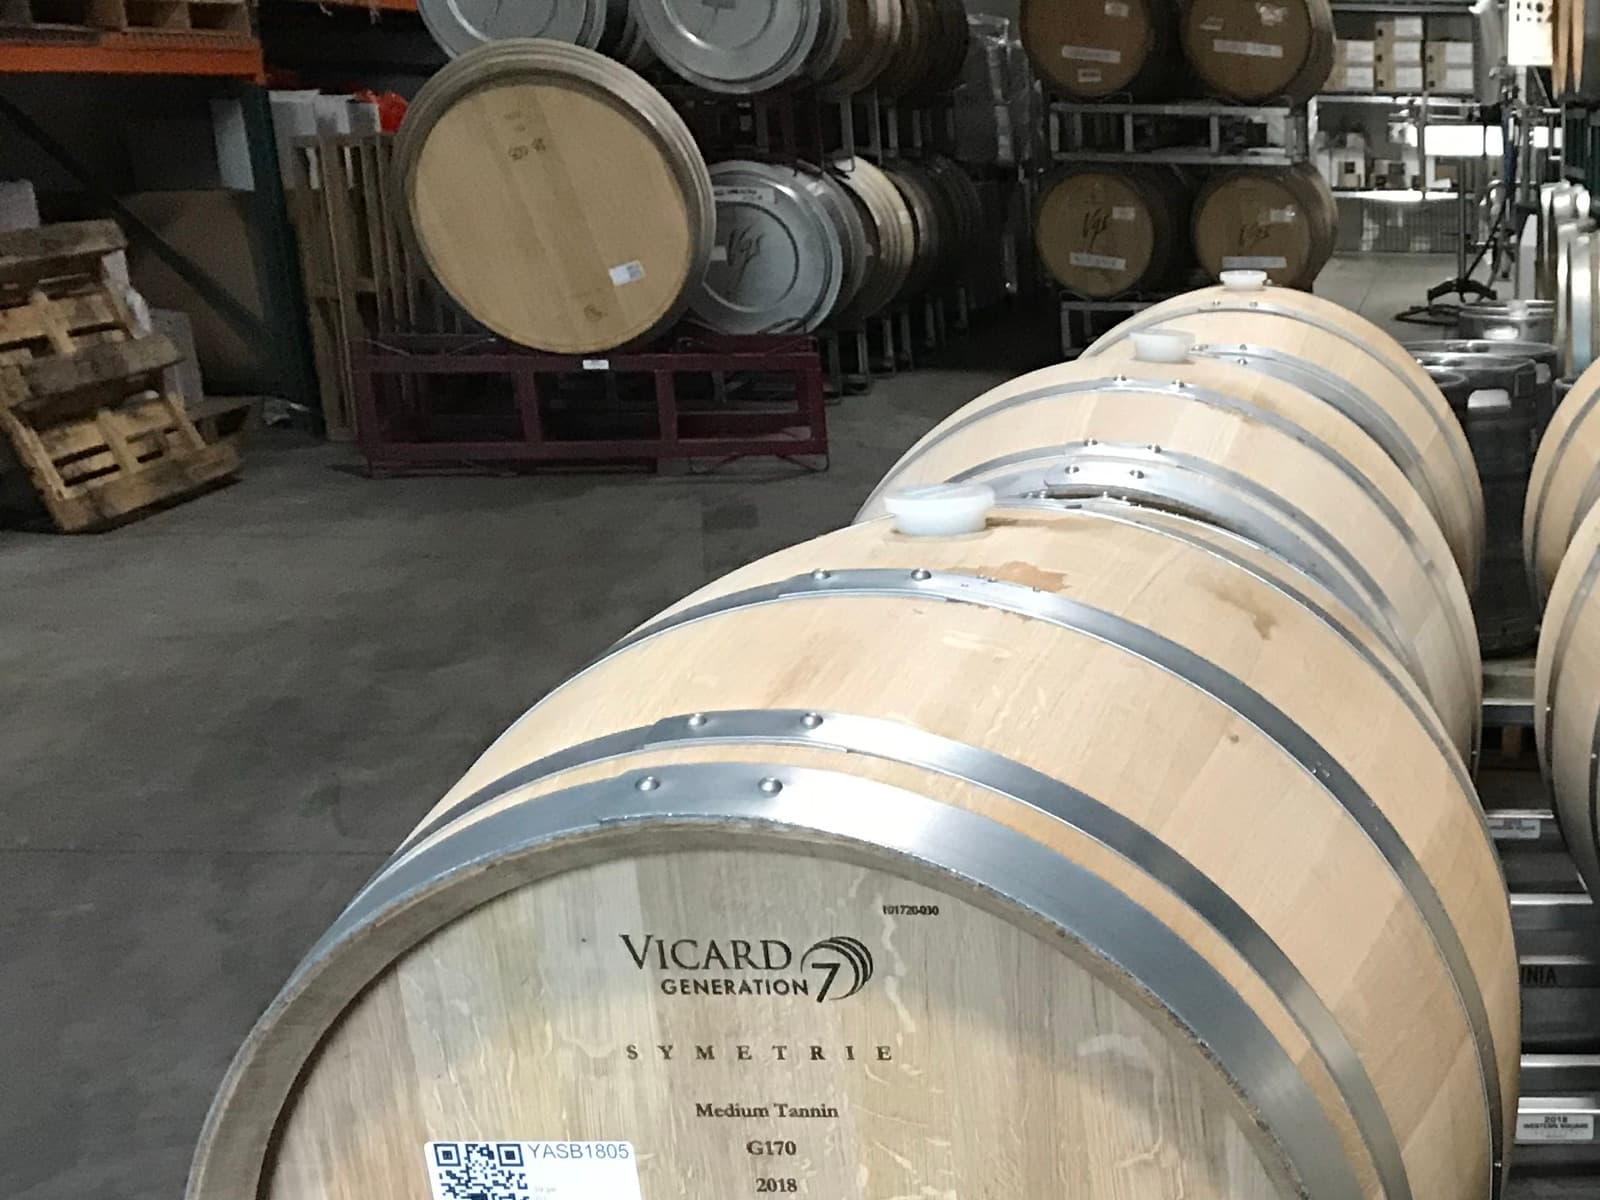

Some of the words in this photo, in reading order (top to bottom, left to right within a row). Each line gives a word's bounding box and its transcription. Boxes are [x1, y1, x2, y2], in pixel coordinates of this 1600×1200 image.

[618, 934, 793, 971] VICARD
[660, 978, 809, 997] GENERATION
[626, 1044, 893, 1062] SYMETRIE
[695, 1102, 769, 1118] Medium
[773, 1102, 840, 1118] Tannin
[527, 1143, 630, 1160] YASB1805
[745, 1140, 798, 1156] G170
[755, 1177, 798, 1193] 2018
